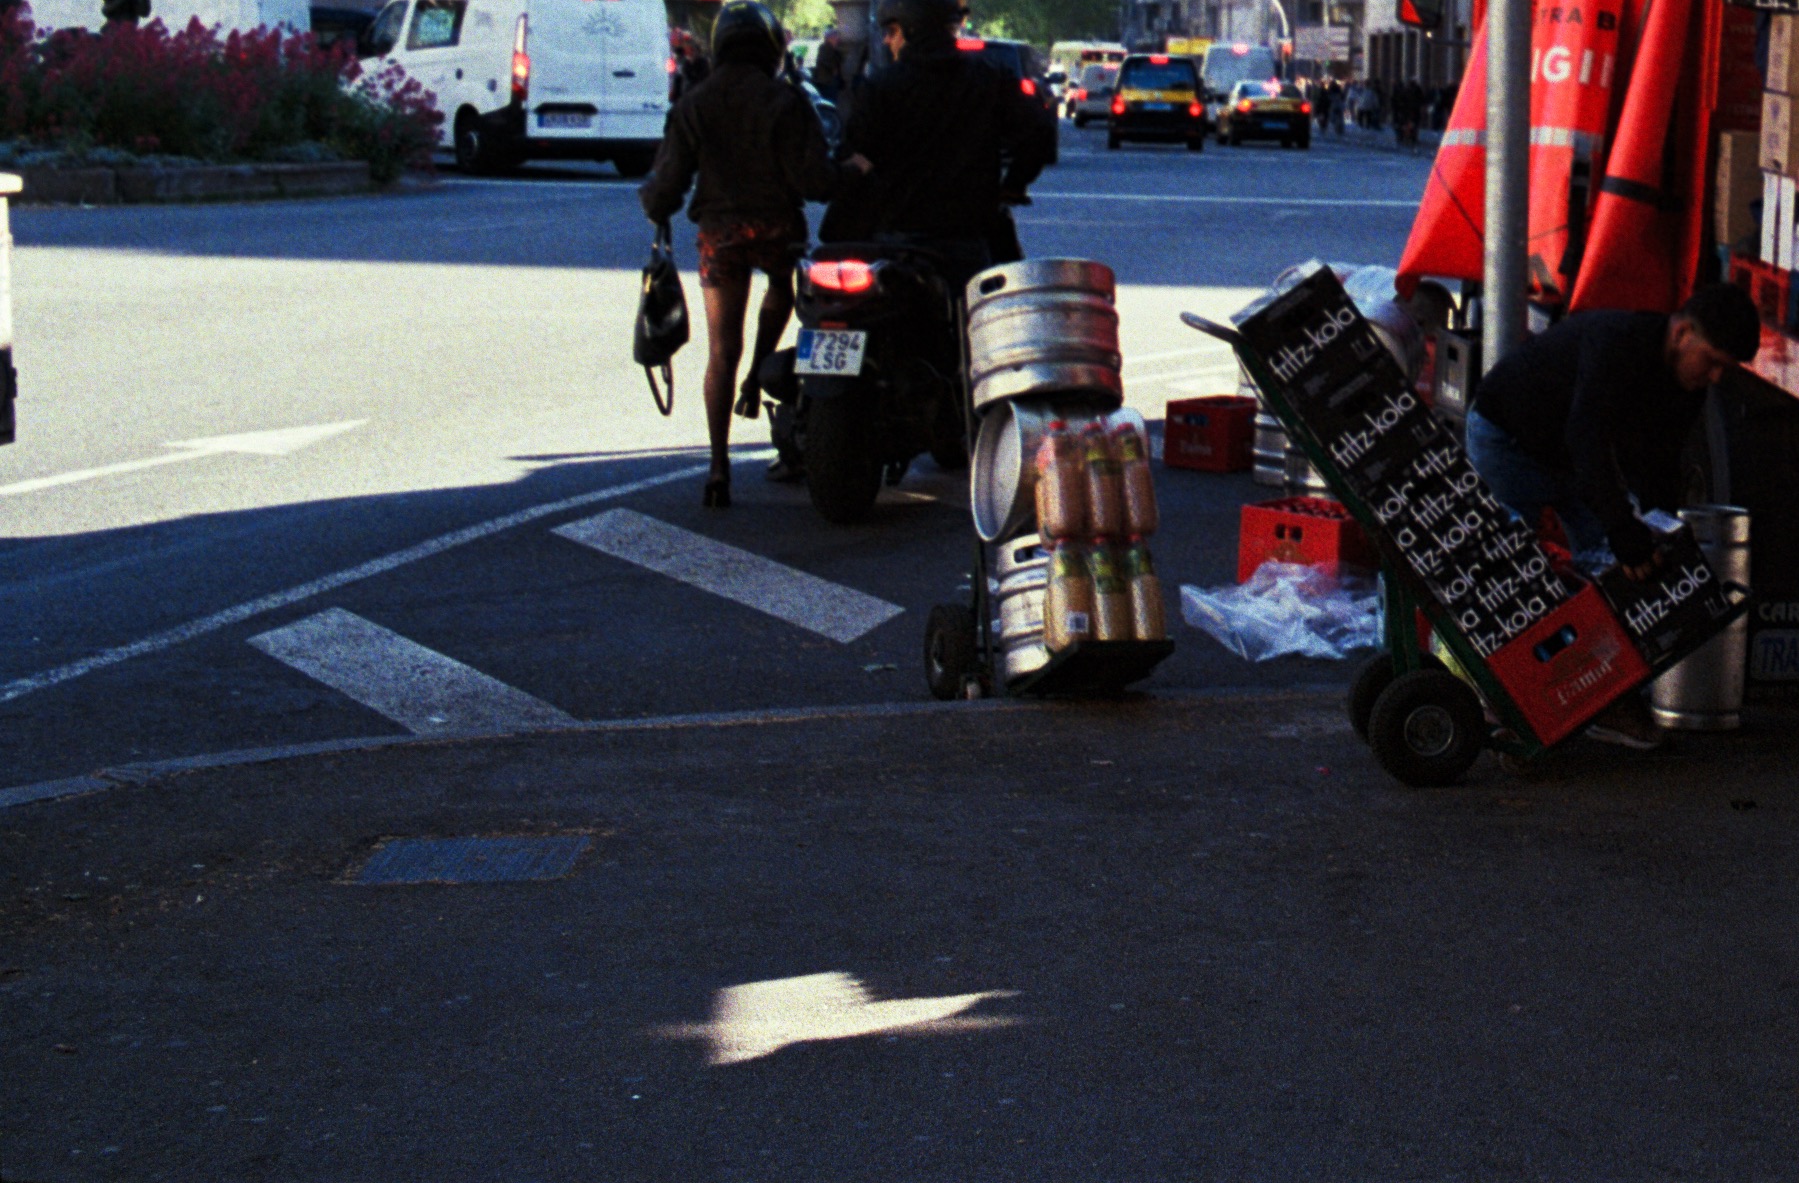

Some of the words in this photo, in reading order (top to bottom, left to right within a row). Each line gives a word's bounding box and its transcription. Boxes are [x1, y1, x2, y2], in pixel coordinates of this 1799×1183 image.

[809, 351, 847, 371] LSG
[813, 330, 860, 352] 7294
[1270, 305, 1356, 383] fritz-kola
[1333, 390, 1417, 469] fritz-kola
[1625, 563, 1711, 636] fritz-kola
